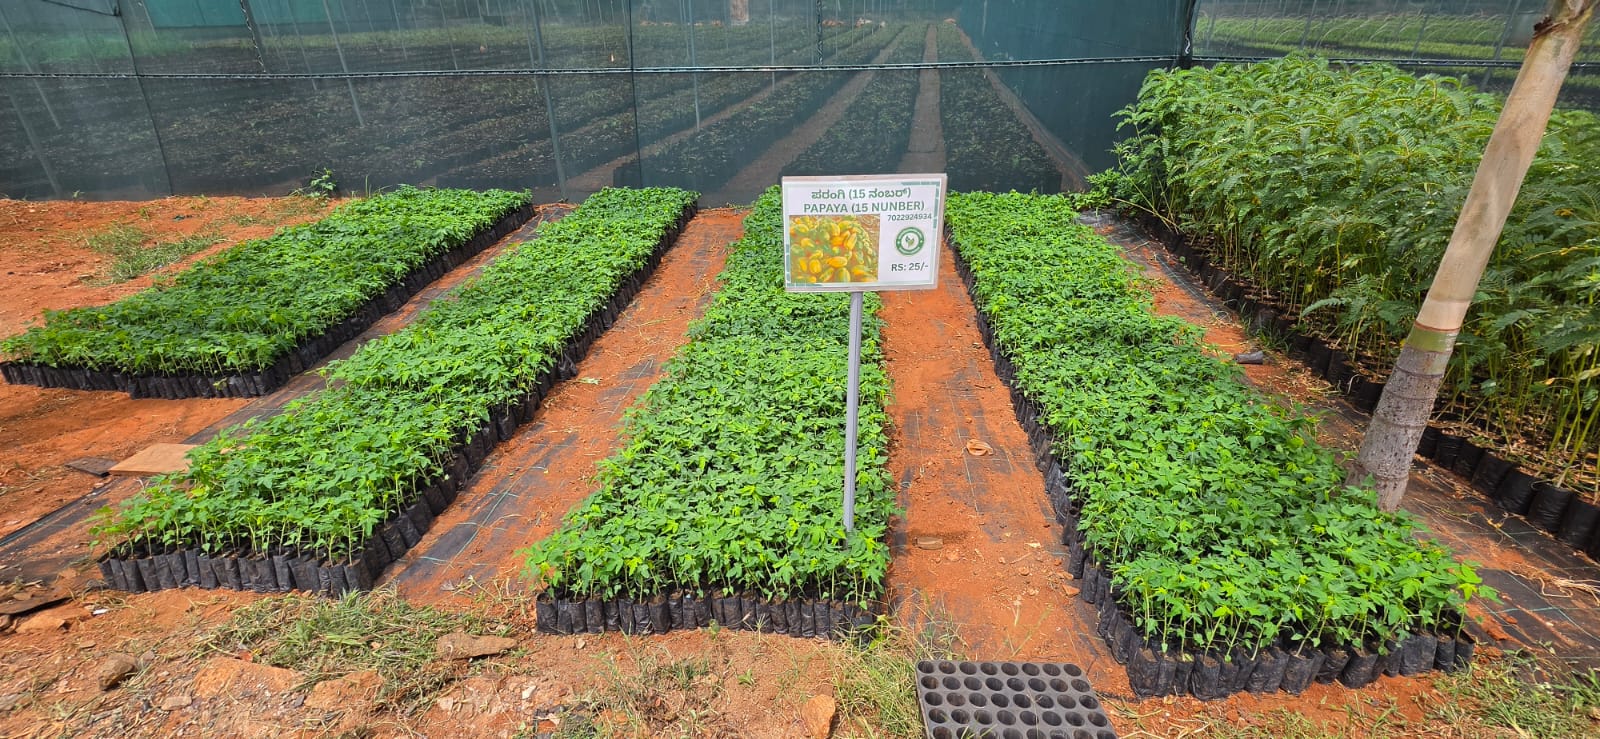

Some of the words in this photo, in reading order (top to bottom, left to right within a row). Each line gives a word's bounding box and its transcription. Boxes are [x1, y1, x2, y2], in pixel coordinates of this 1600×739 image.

[811, 189, 845, 199] ಪರಂಗಿ
[849, 188, 865, 200] (15
[868, 187, 911, 199] ನಂಬರ್)
[804, 203, 848, 213] PAPAYA
[851, 202, 868, 214] (15
[871, 201, 925, 212] NUNBER)
[887, 213, 932, 222] 7022924934
[891, 263, 906, 272] RS:
[908, 261, 928, 271] 25/-
